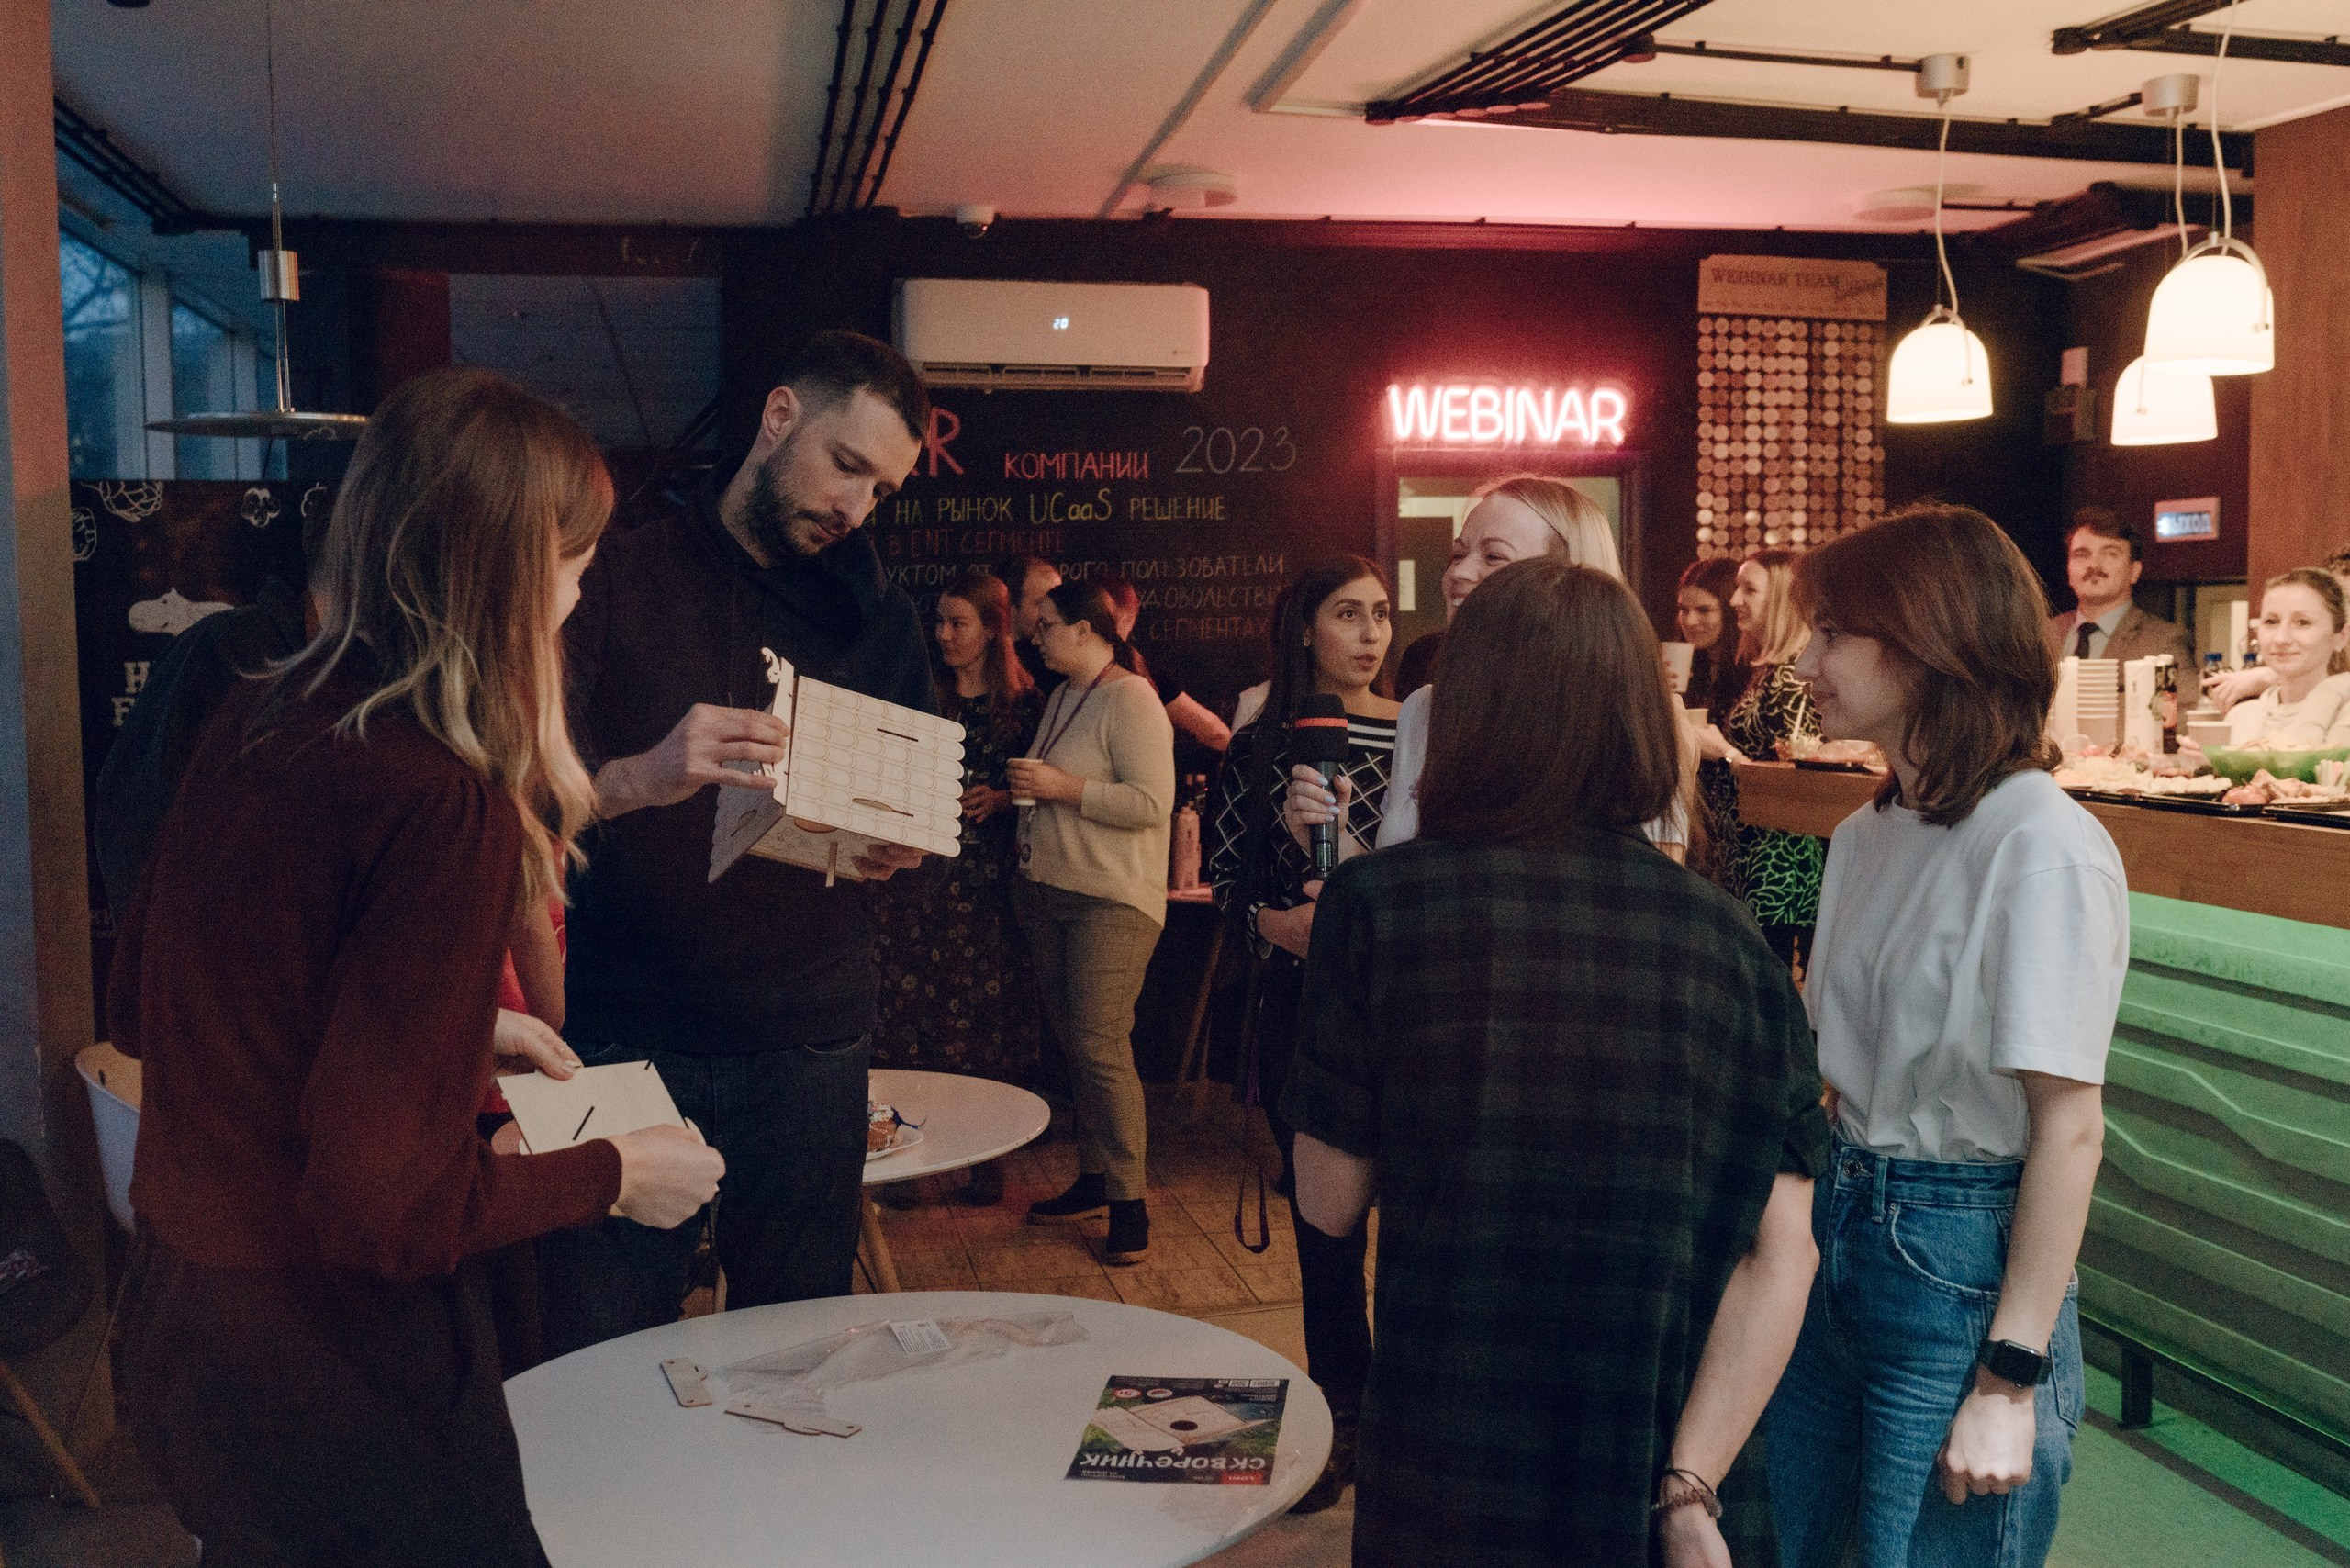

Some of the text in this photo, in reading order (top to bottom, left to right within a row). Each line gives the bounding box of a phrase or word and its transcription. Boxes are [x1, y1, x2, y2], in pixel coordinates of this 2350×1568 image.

[1386, 383, 1626, 447] WEBINAR
[910, 405, 1297, 480] R КОМПАНИИ 2023
[894, 498, 923, 525] НА
[937, 496, 1013, 523] РЫНОК
[1029, 487, 1113, 525] UCaaS
[1129, 496, 1226, 521] РЕШЕНИЕ
[884, 563, 957, 587] УКТОМ
[1059, 559, 1109, 581] РОГО
